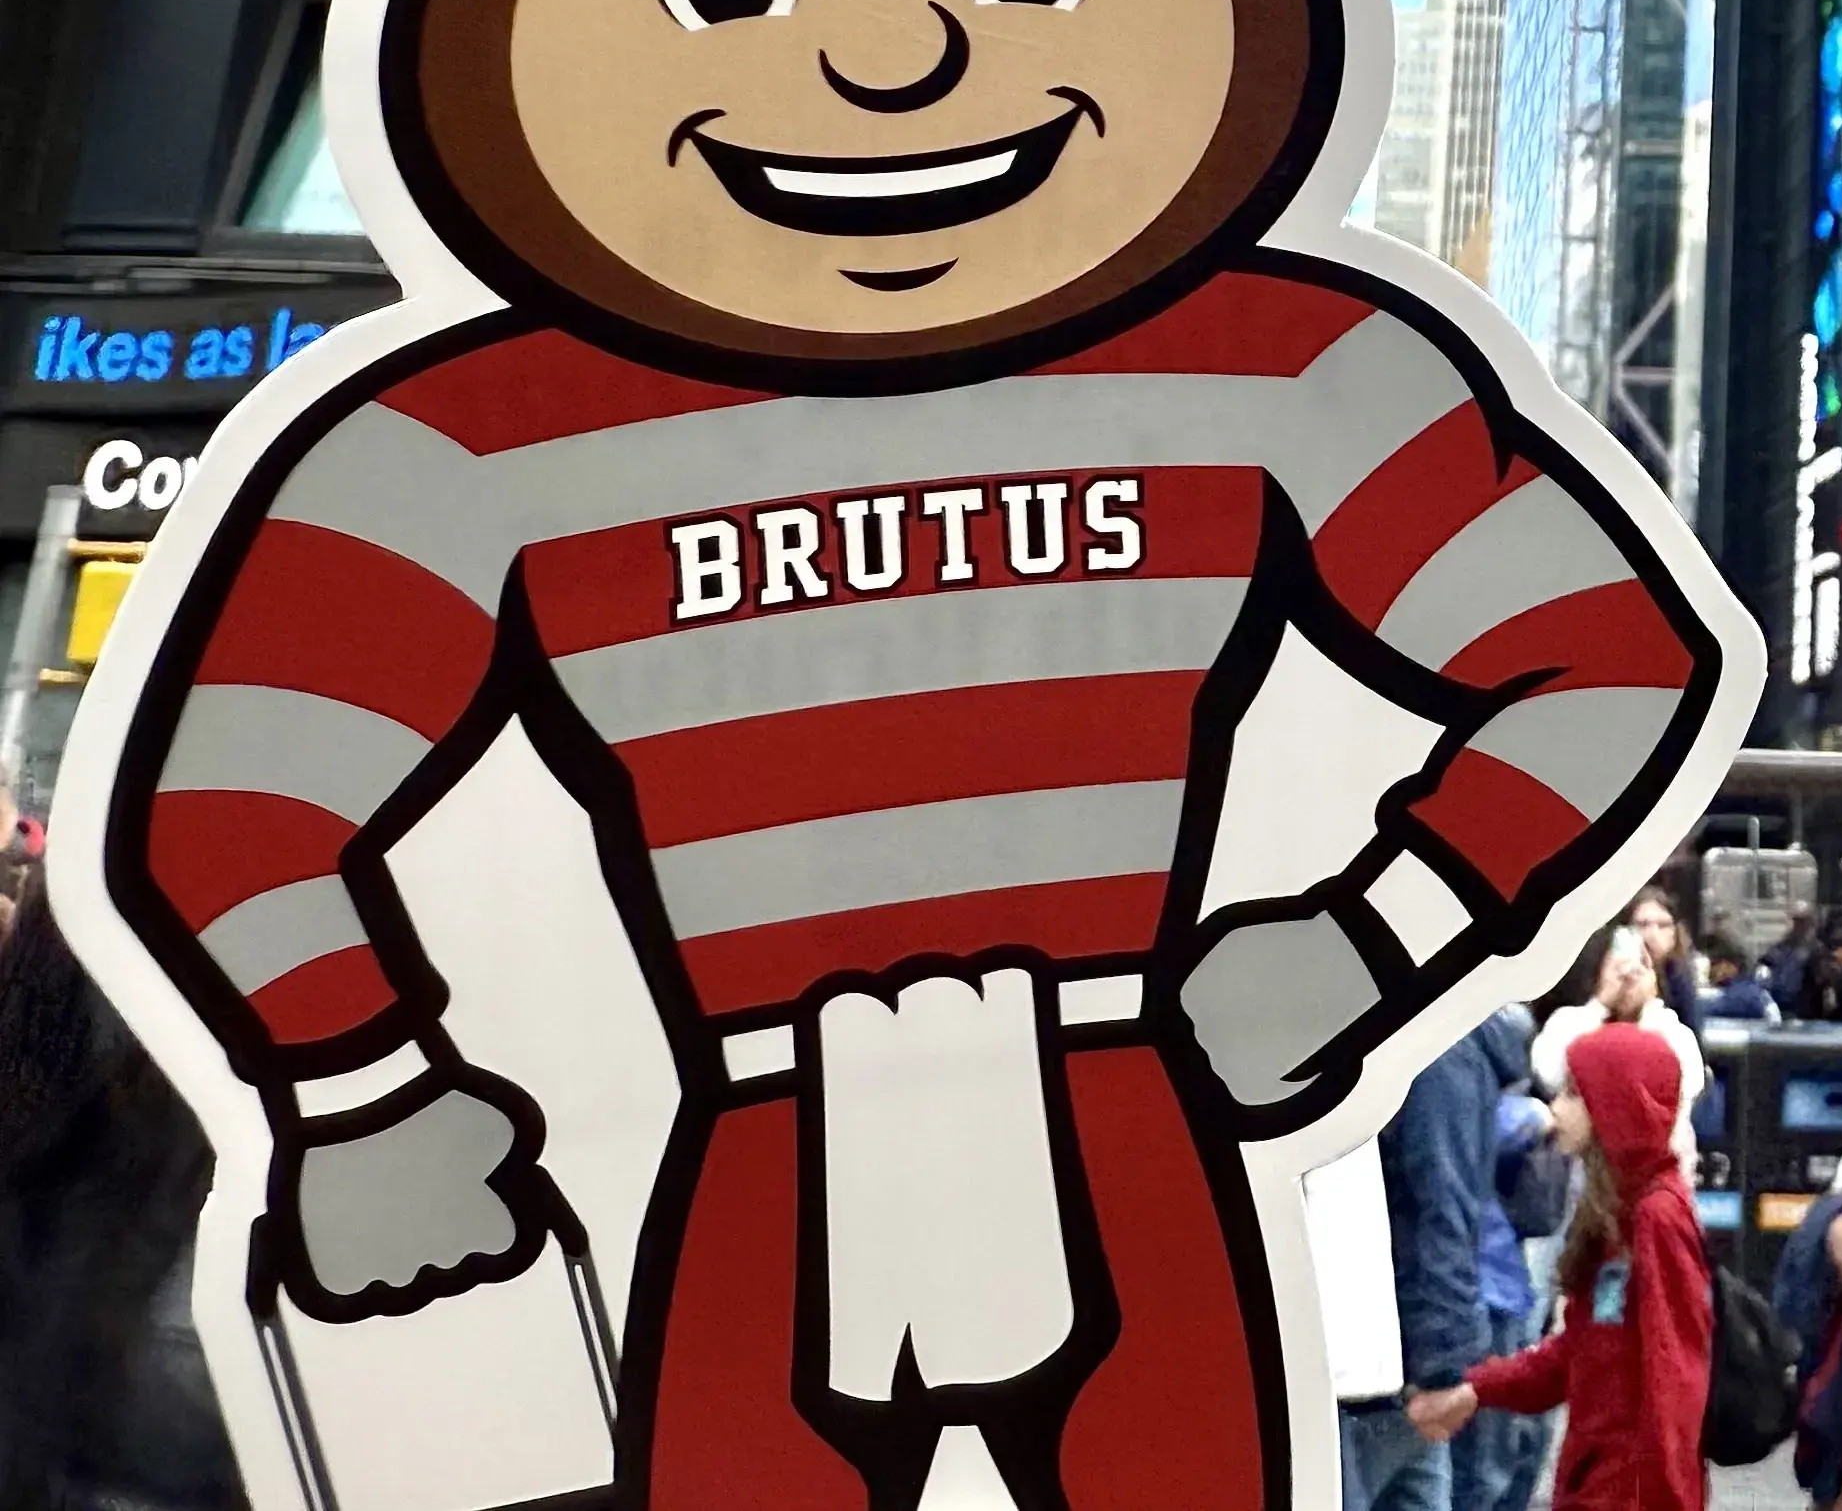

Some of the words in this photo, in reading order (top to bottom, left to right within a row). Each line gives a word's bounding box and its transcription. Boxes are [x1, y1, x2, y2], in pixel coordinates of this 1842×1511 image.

[183, 324, 254, 380] as
[84, 439, 198, 510] Co
[670, 478, 1143, 622] BRUTUS
